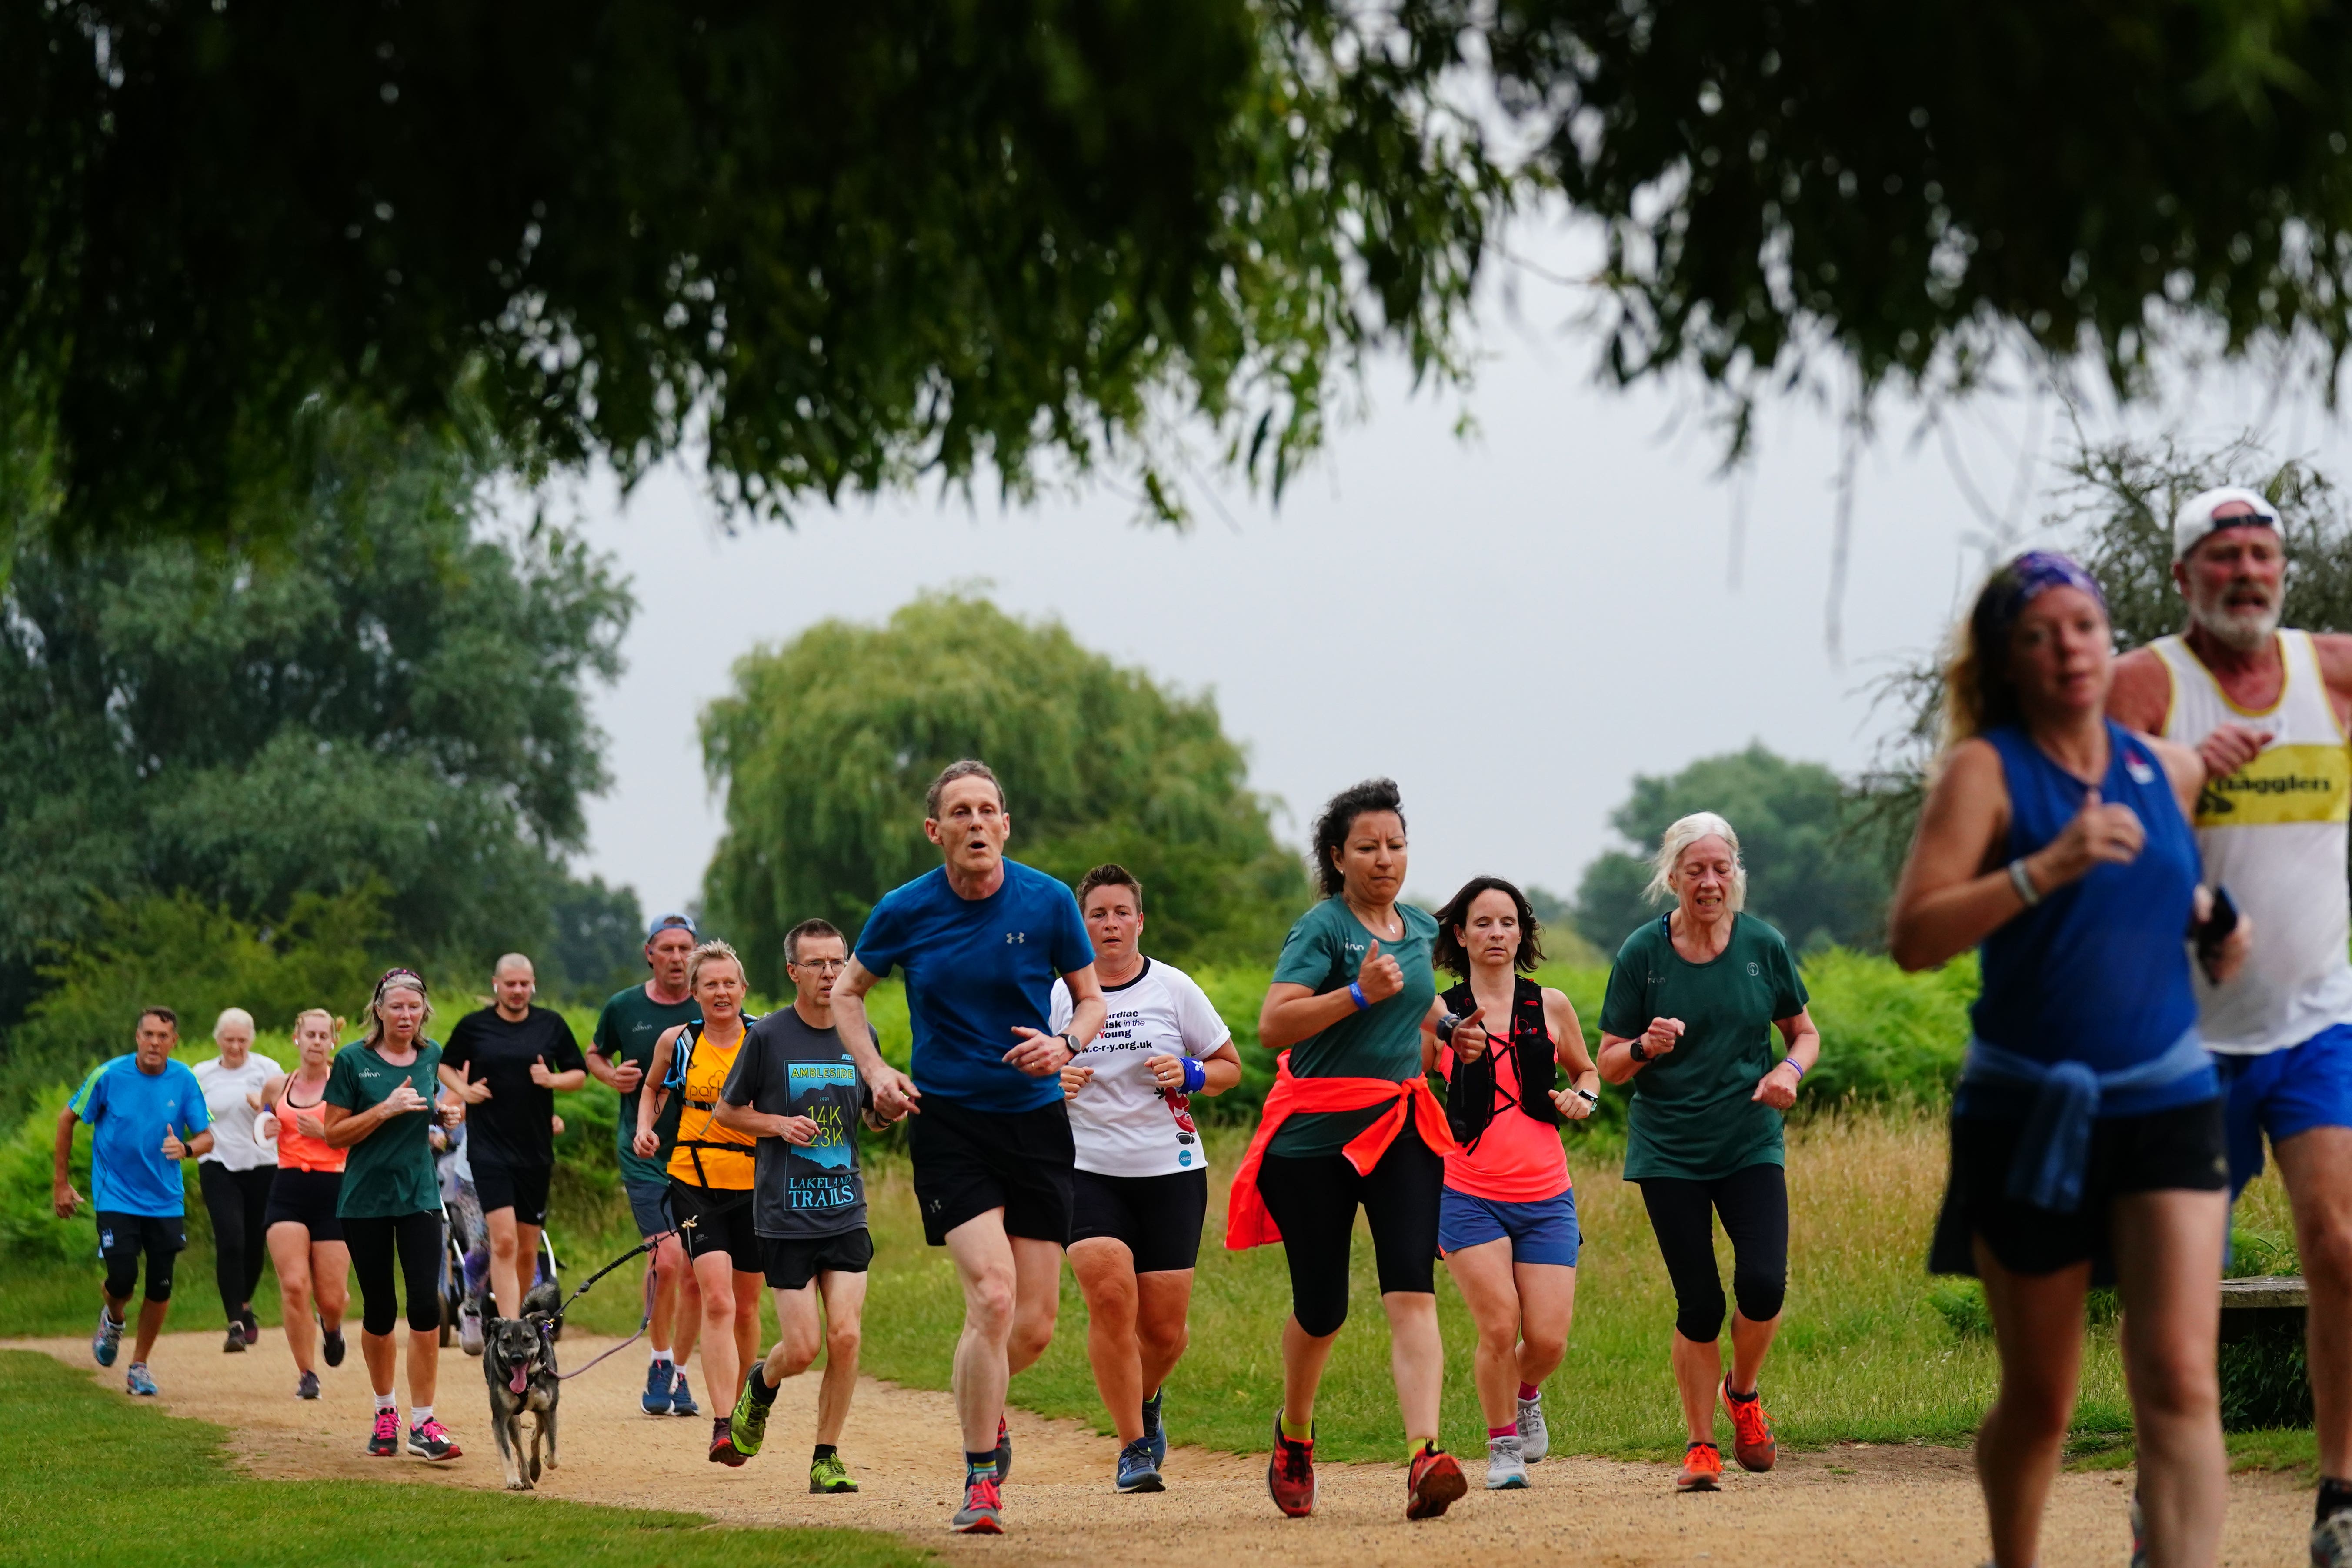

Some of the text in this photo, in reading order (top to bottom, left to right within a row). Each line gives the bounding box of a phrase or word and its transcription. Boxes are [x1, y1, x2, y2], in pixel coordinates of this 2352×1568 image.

[1107, 1011, 1138, 1019] ardiac
[1102, 1020, 1121, 1029] isk
[1098, 1029, 1131, 1039] Young
[791, 1067, 854, 1079] AMBLESIDE
[689, 1076, 722, 1100] park
[808, 1105, 842, 1126] 14K
[789, 1174, 851, 1189] LAKELAND
[788, 1185, 854, 1208] TRAILS
